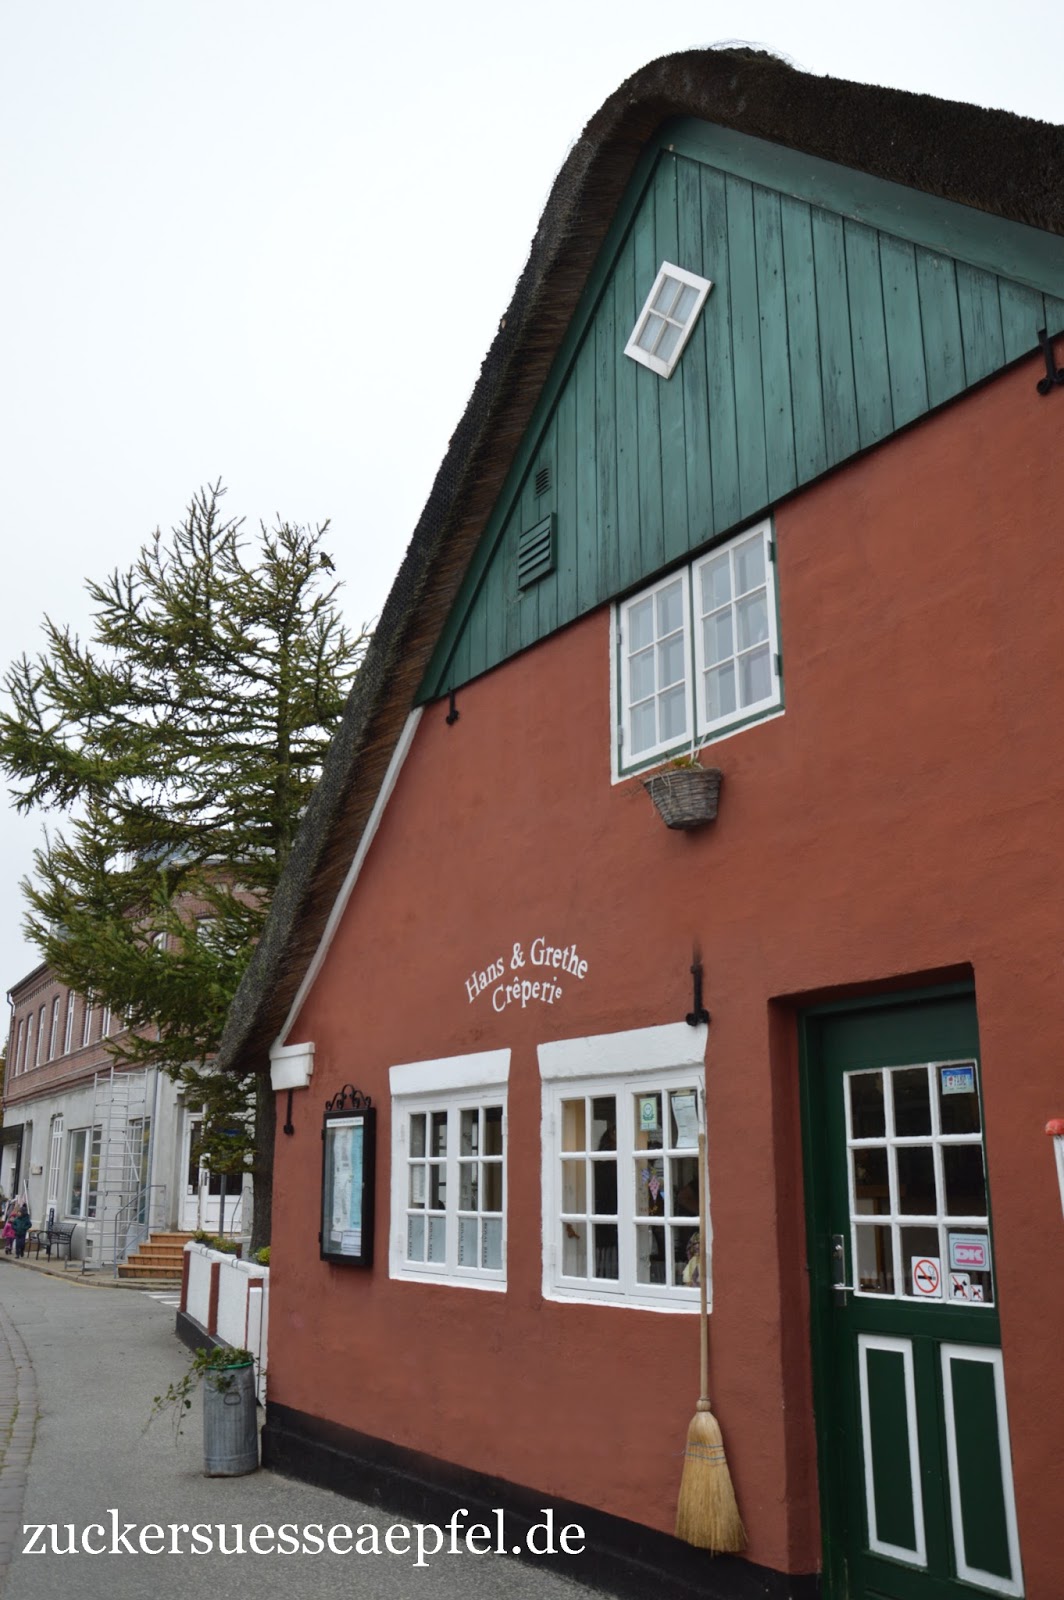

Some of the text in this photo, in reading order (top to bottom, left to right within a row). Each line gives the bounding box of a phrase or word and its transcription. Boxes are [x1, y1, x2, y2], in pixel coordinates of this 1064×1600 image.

[464, 936, 588, 1004] Hans & Grethe
[492, 976, 562, 1012] Crêperie
